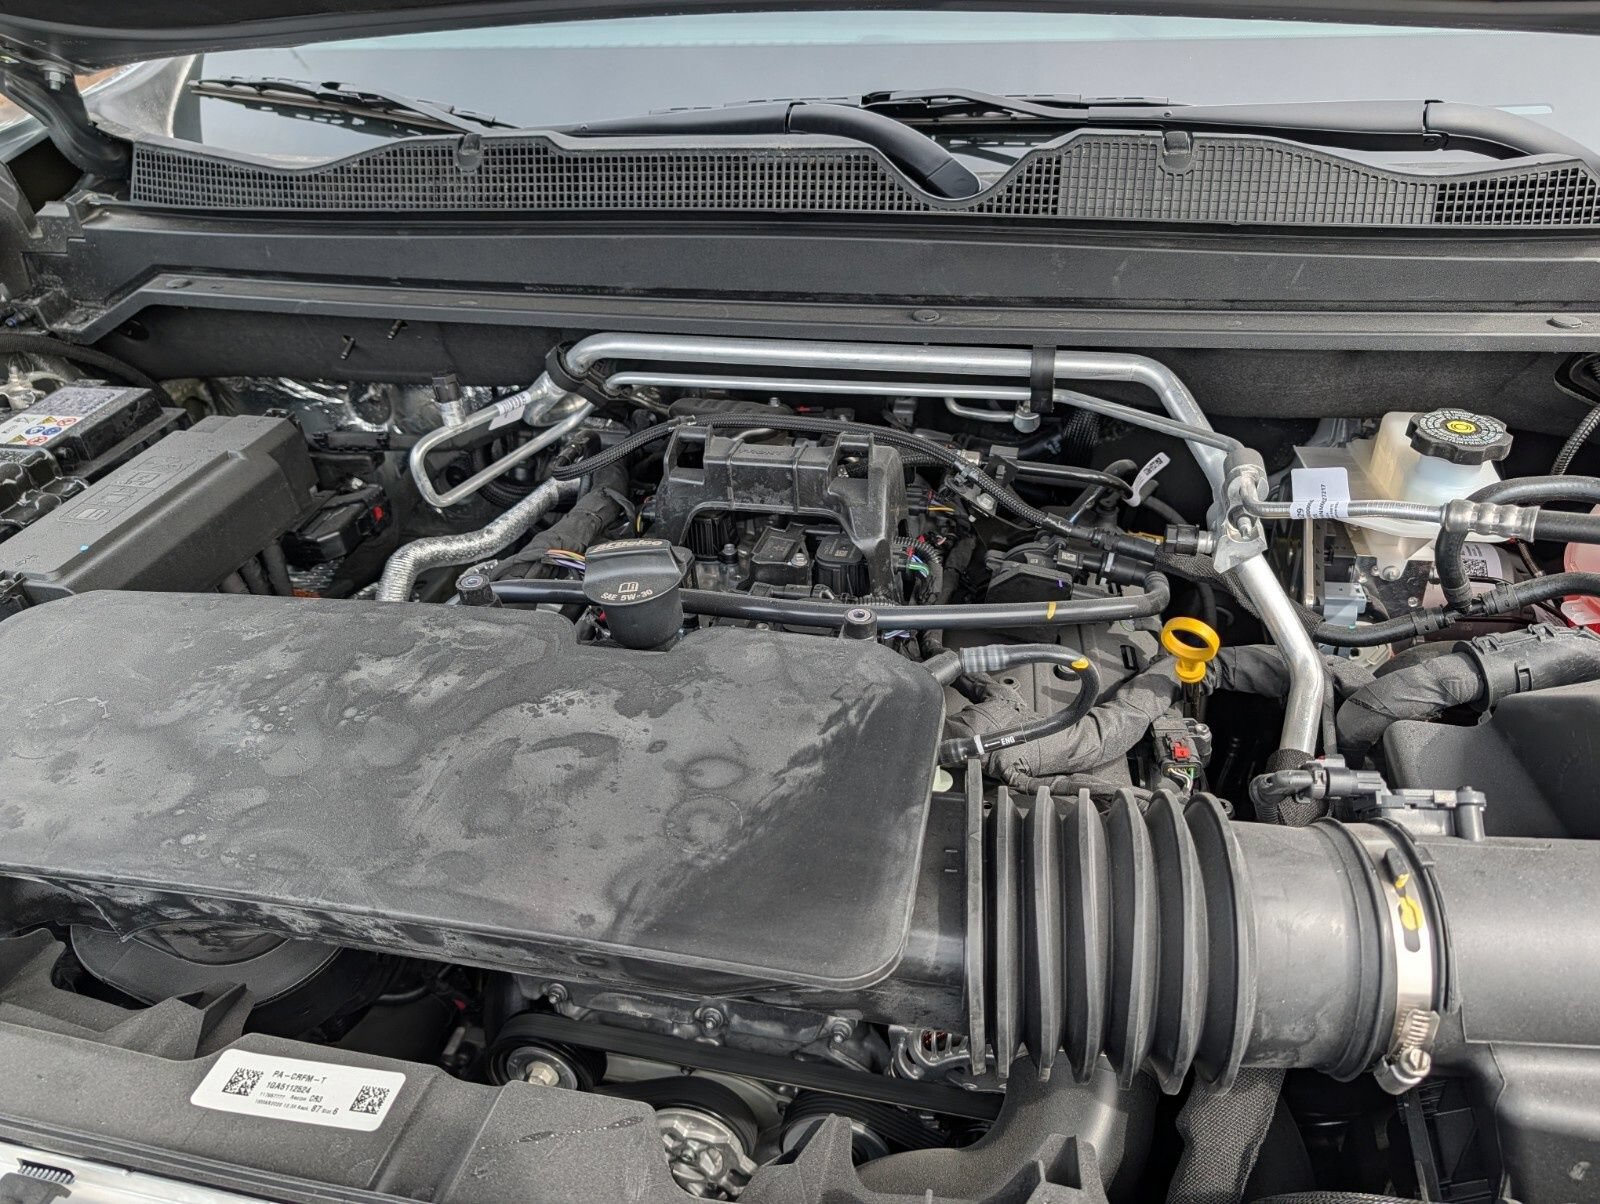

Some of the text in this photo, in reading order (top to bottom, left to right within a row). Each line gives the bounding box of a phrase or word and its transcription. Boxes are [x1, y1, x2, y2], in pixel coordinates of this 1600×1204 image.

[601, 589, 653, 601] SAE 5W-30
[1000, 735, 1015, 746] ENG
[332, 1107, 340, 1116] 6
